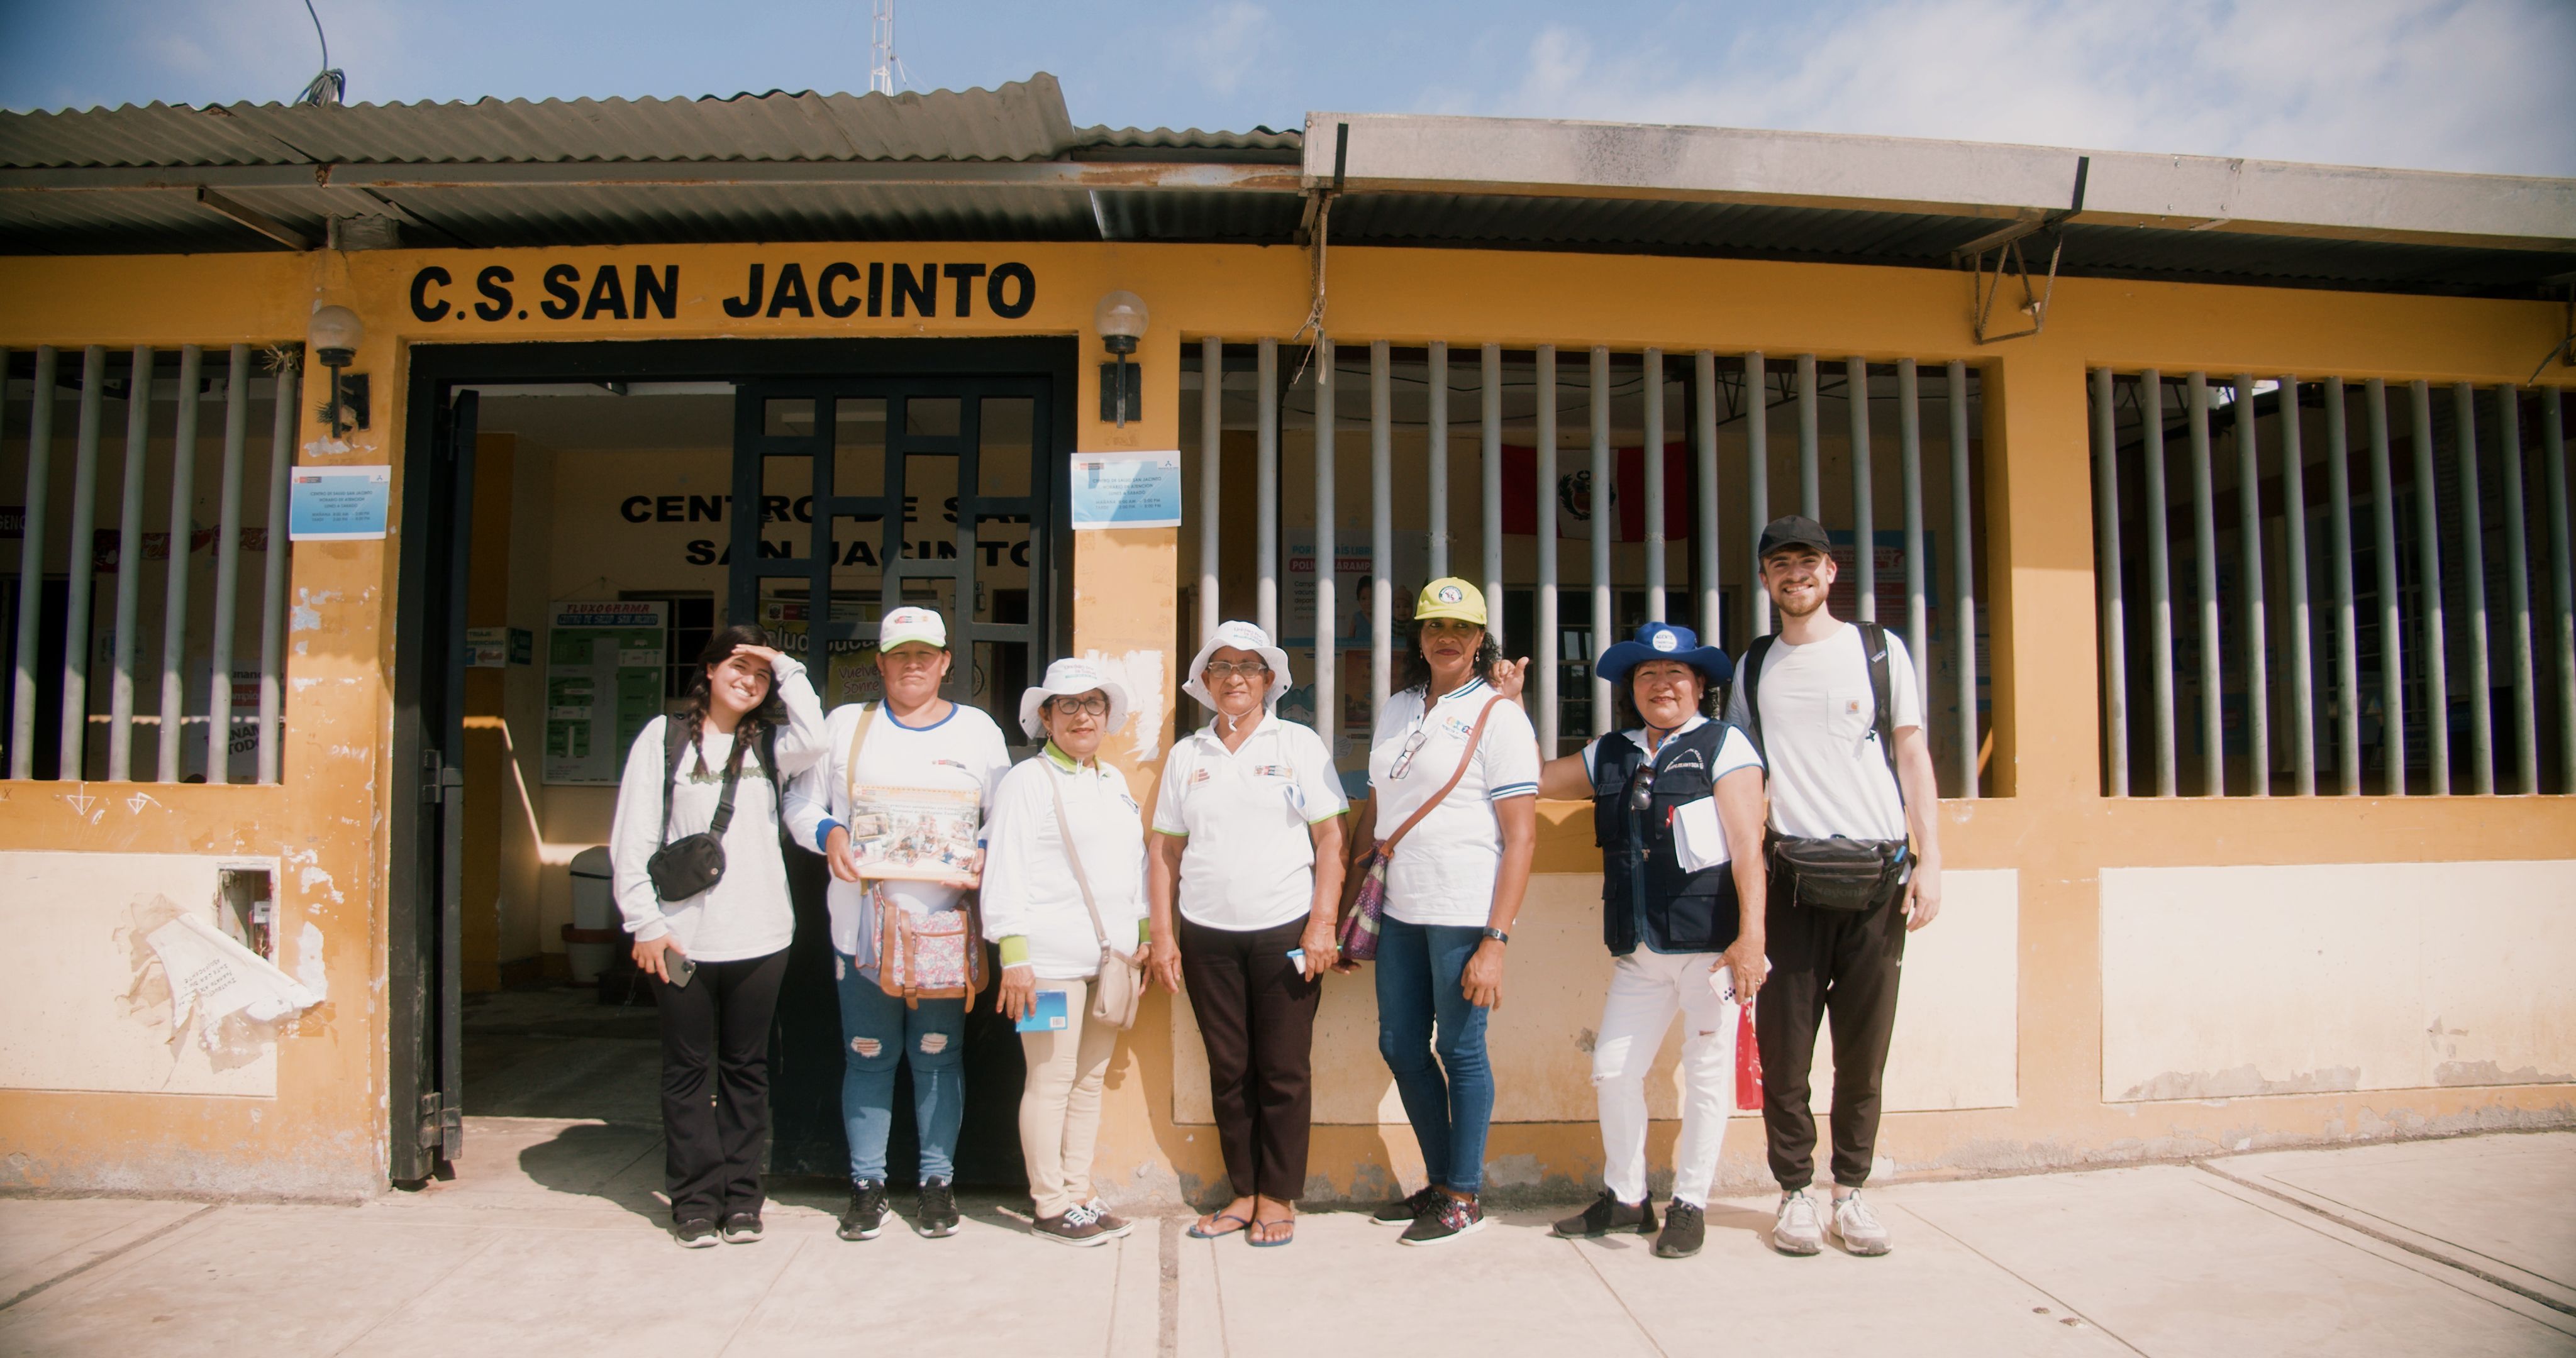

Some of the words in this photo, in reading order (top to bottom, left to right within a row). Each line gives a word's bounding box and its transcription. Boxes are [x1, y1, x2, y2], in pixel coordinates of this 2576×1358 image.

[722, 262, 1037, 319] JACINTO
[621, 495, 814, 523] CENRO
[1292, 545, 1311, 554] POR
[1292, 561, 1316, 570] POLI
[567, 604, 650, 614] FLUXOGRAMA
